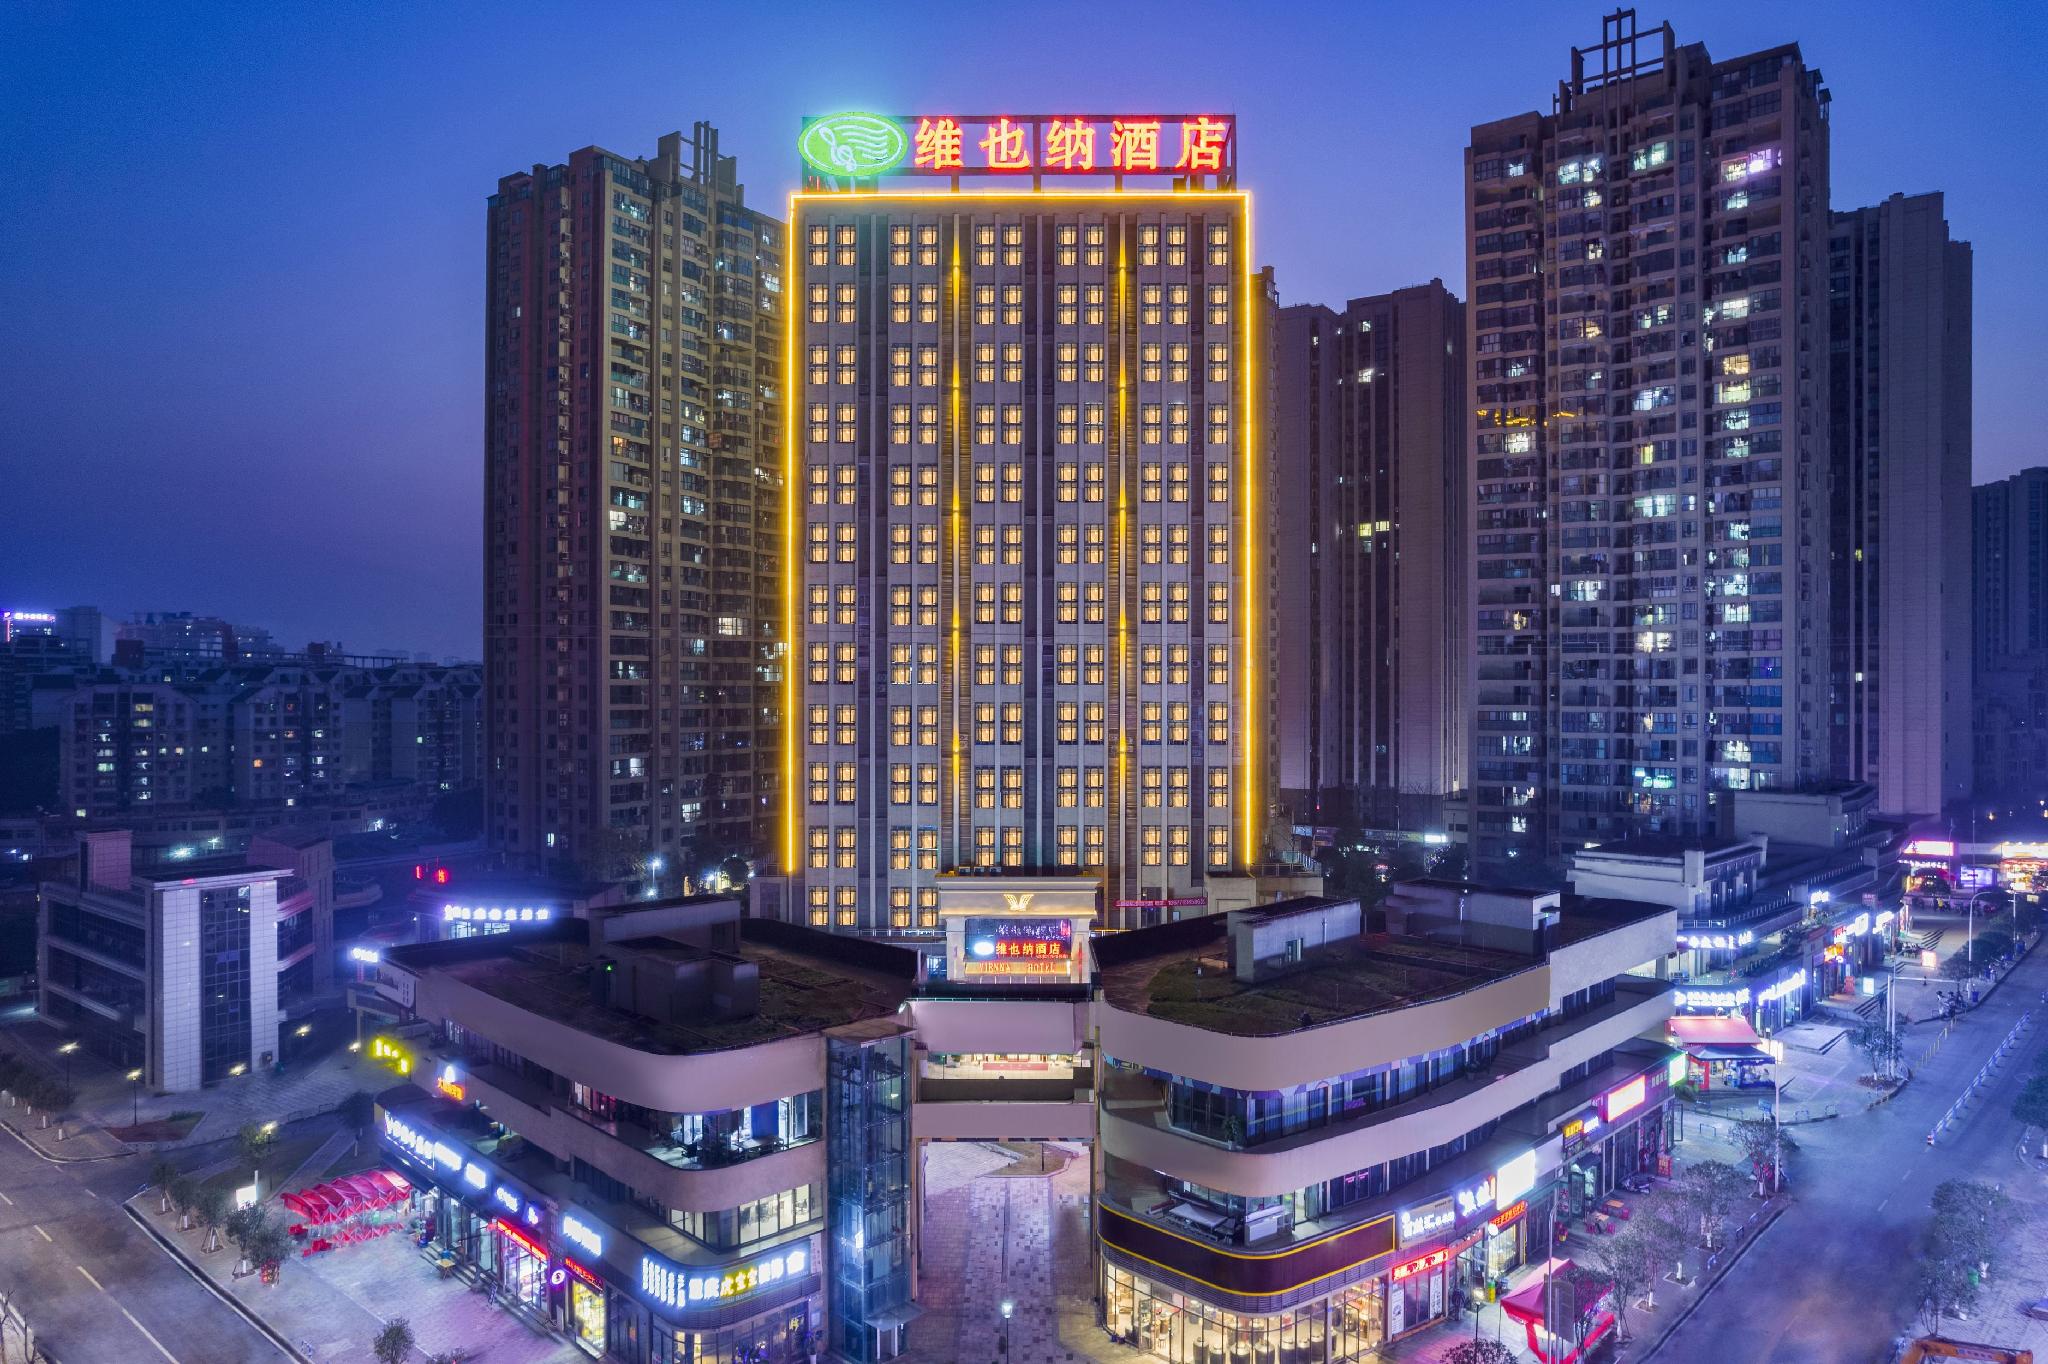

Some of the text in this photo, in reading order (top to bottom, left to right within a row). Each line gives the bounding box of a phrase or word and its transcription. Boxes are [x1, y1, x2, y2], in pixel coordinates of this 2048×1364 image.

[914, 117, 1226, 171] 维也纳酒店
[996, 943, 1060, 955] 维也纳酒店
[979, 962, 1055, 974] VIENNA HOTEL
